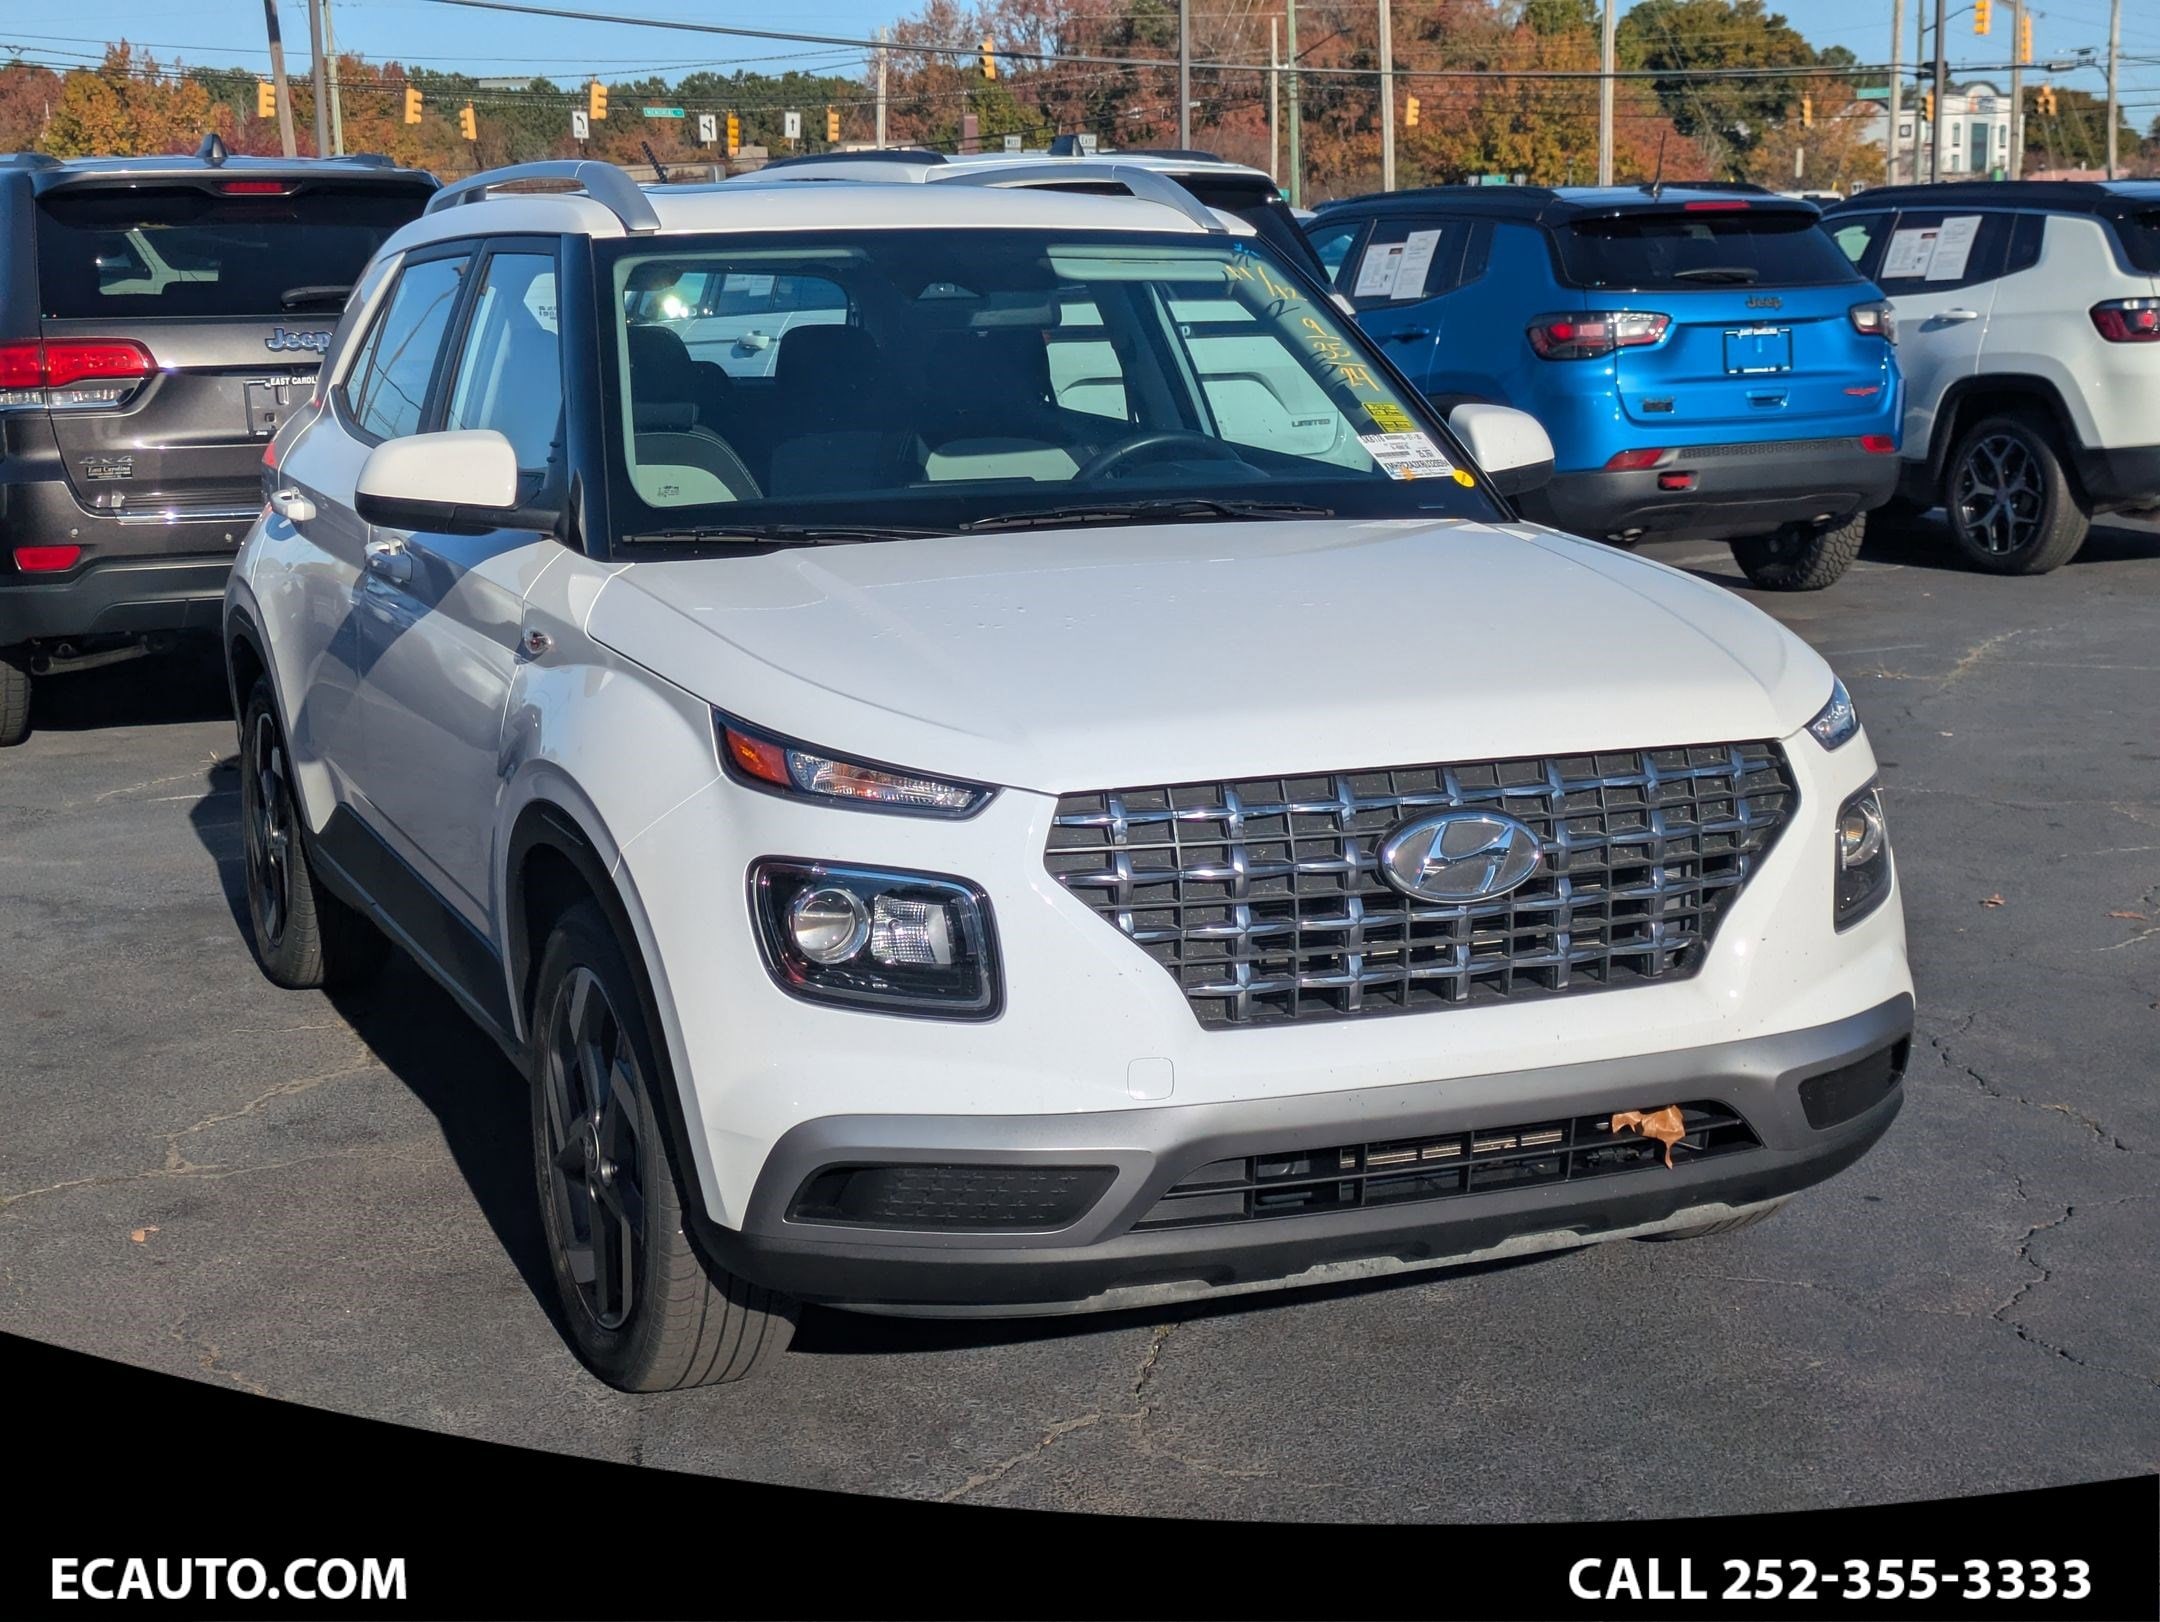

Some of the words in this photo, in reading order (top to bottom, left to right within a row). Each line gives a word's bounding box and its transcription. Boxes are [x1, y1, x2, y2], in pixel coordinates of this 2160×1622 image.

[1745, 294, 1783, 311] Jeep
[264, 326, 334, 355] Jeep
[270, 377, 290, 386] EAST
